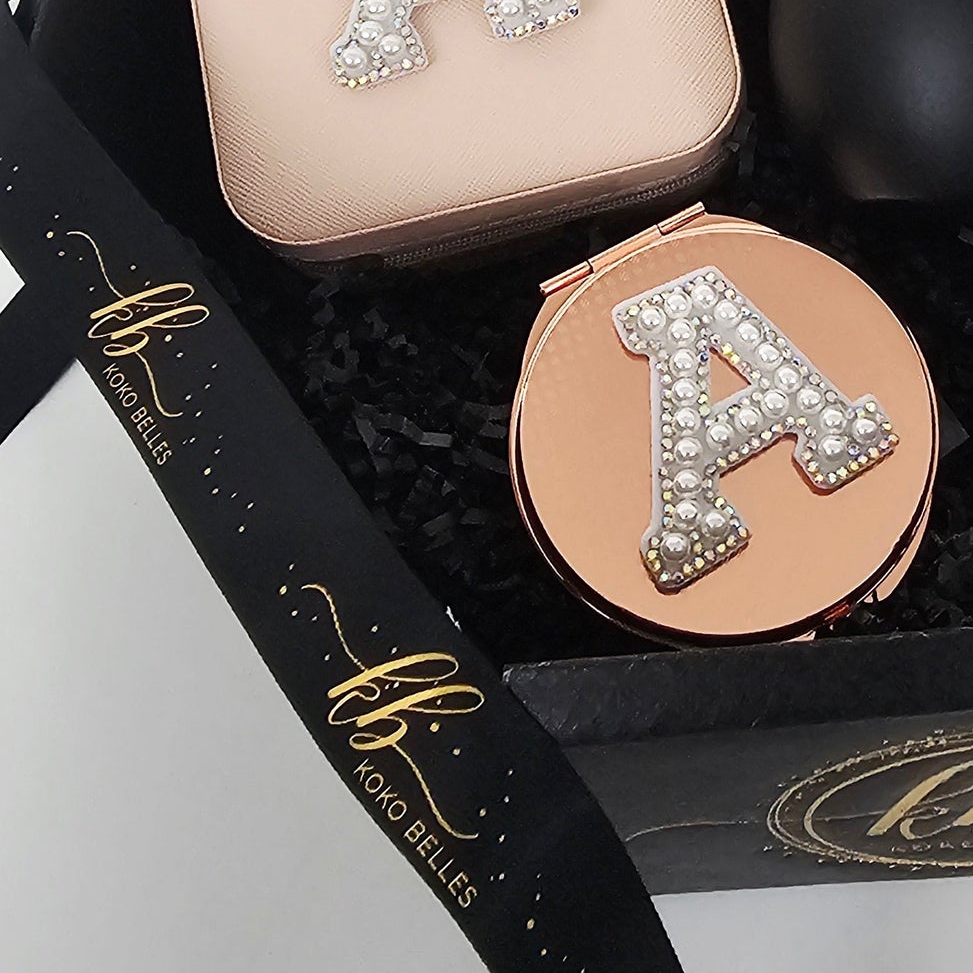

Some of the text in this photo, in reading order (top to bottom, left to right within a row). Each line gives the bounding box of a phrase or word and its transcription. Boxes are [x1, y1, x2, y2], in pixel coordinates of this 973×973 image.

[102, 362, 173, 466] KOKO BELLES
[611, 265, 902, 595] A
[352, 758, 478, 909] KOKO BELLES
